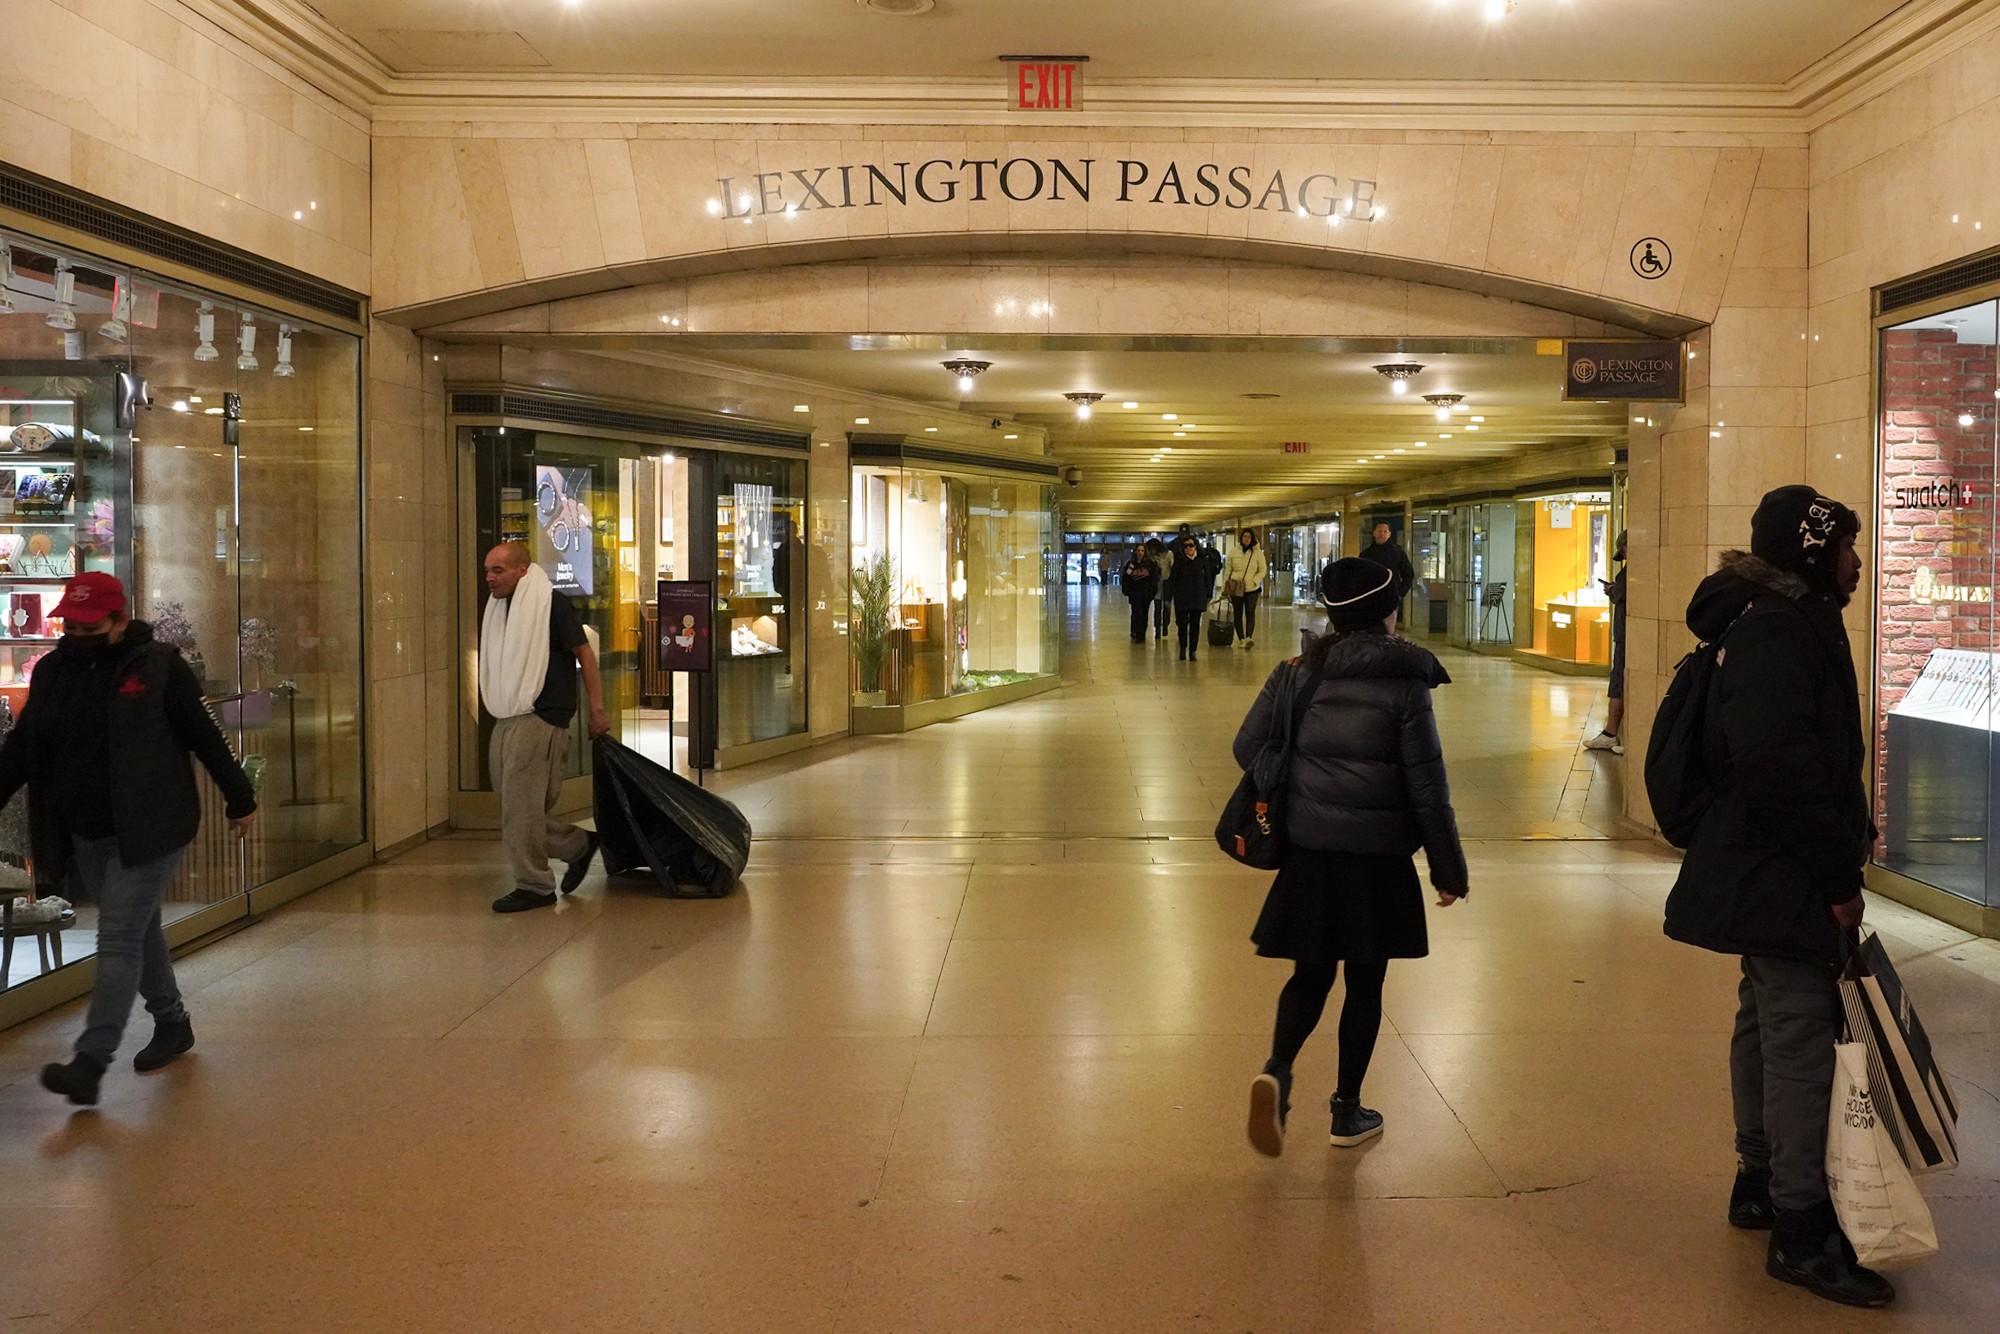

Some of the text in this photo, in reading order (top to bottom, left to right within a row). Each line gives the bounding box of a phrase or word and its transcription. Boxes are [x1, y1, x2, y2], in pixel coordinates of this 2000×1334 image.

[1018, 64, 1076, 109] EXIT
[716, 157, 1379, 223] LEXINGTON PASSAGE
[1600, 359, 1673, 371] LEXINGTON
[1600, 372, 1657, 383] PASSAGE
[1895, 479, 1960, 509] swatch
[1846, 1097, 1873, 1114] HOUSE
